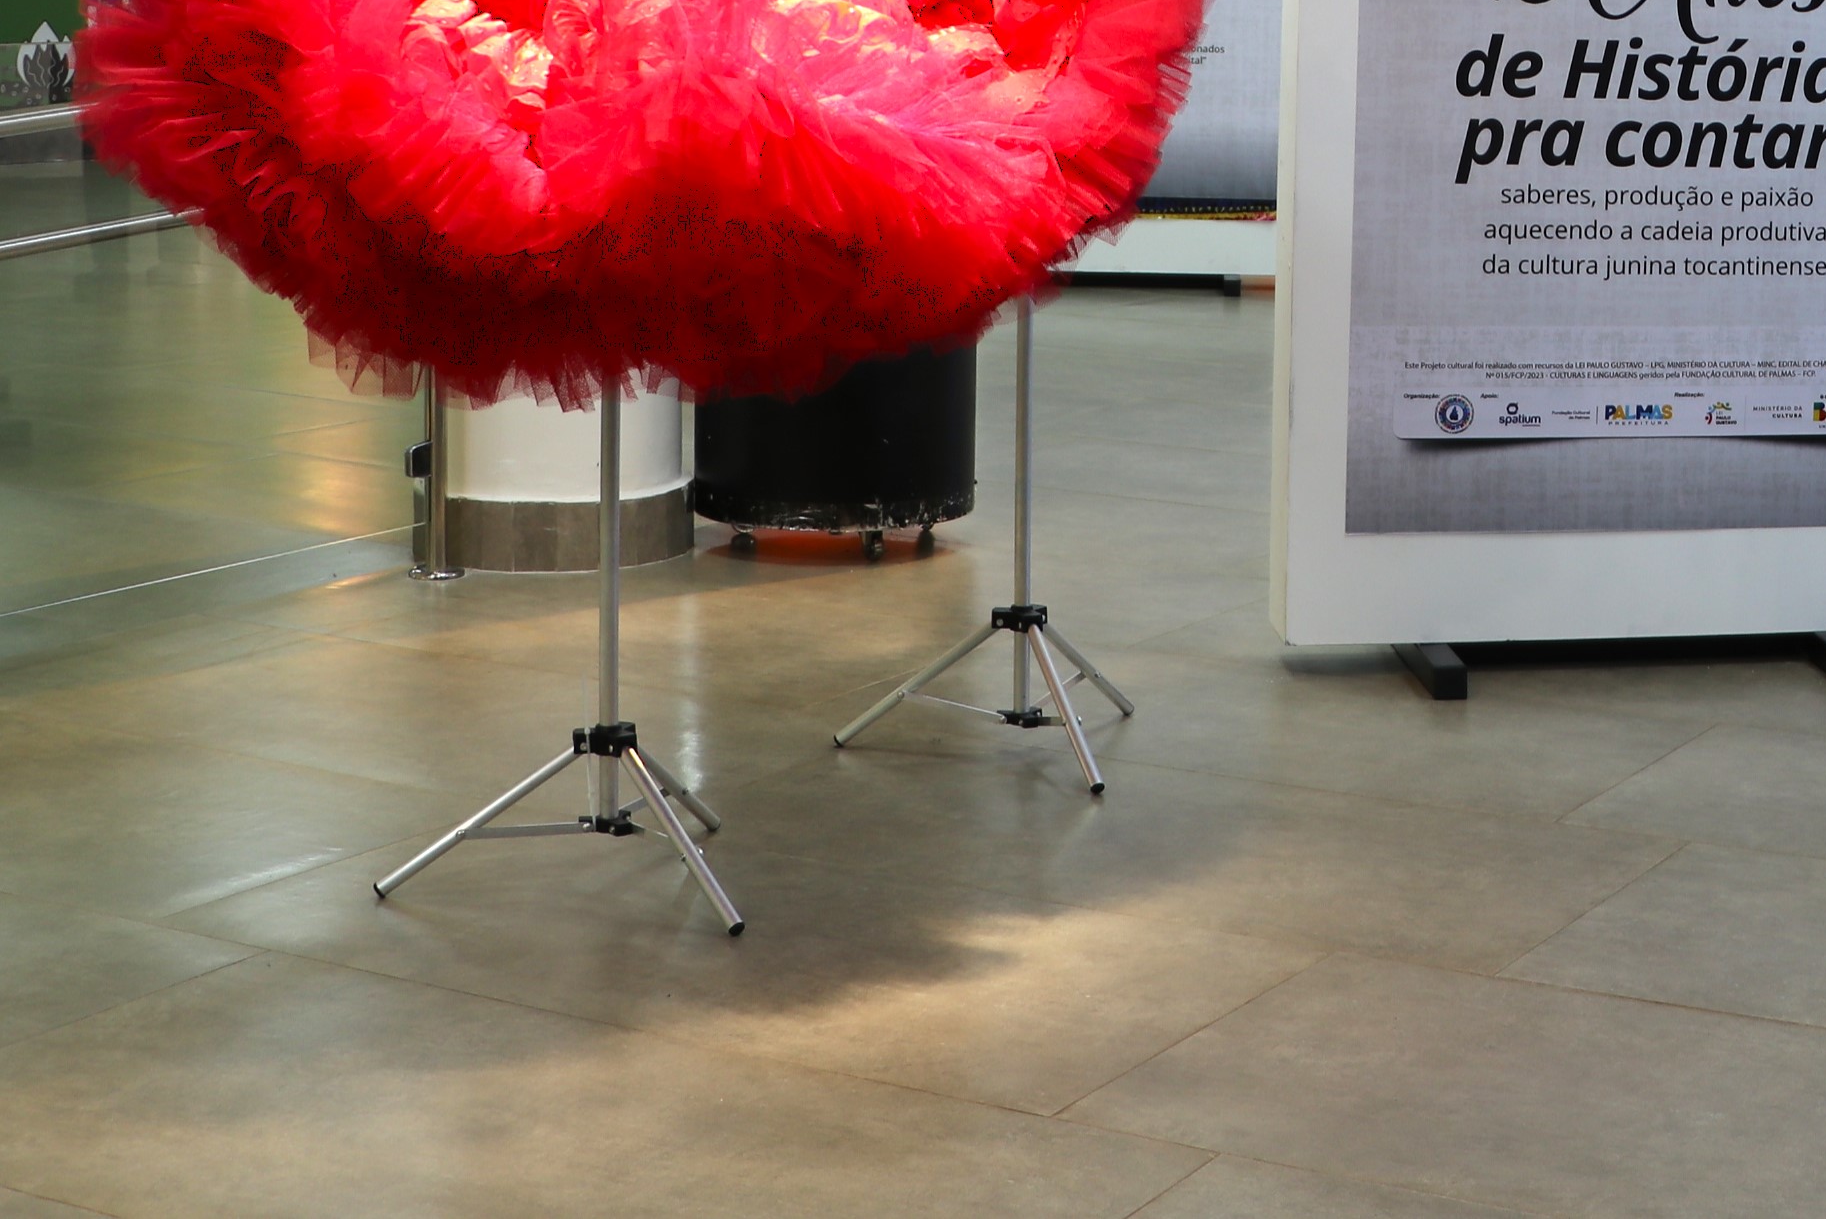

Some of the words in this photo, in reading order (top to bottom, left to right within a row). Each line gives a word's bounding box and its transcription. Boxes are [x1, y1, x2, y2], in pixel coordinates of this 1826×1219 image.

[1455, 33, 1544, 99] de
[1454, 118, 1585, 185] pra
[1501, 182, 1596, 208] saberes,
[1604, 184, 1714, 212] produção
[1721, 191, 1734, 207] e
[1741, 186, 1814, 213] paixão
[1484, 218, 1613, 246] aquecendo
[1620, 225, 1633, 241] a
[1641, 219, 1713, 241] cadeia
[1721, 220, 1826, 247] produtiva
[1482, 253, 1510, 275] da
[1518, 254, 1598, 275] cultura
[1603, 254, 1676, 281] junina
[1683, 255, 1826, 276] tocantinense
[1499, 413, 1541, 427] spatium
[1604, 404, 1673, 421] PALMAS
